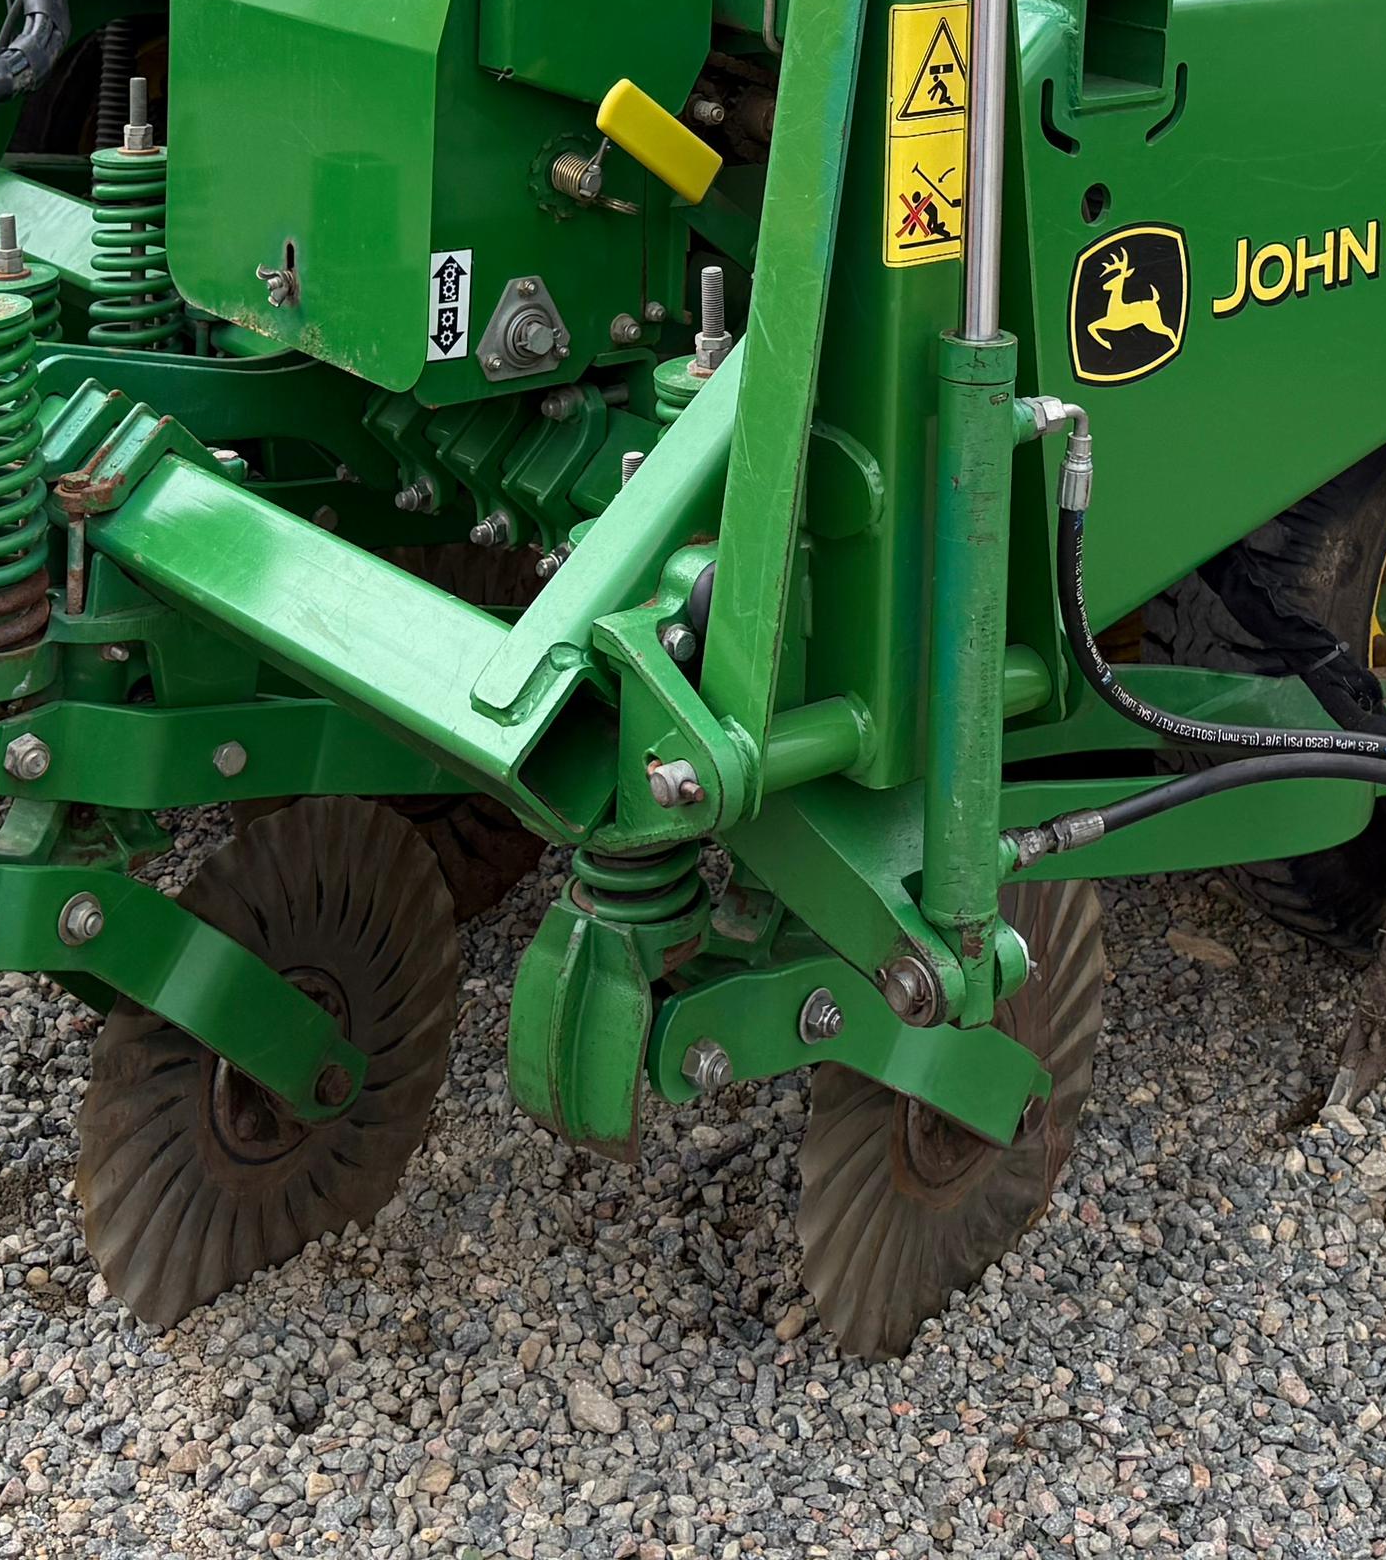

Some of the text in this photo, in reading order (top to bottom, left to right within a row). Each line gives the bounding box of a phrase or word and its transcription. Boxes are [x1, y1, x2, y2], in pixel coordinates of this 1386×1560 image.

[1212, 220, 1377, 316] JOHN
[1111, 684, 1138, 711] 100R17
[1136, 704, 1152, 721] SAE
[1156, 717, 1173, 731] R17
[1305, 736, 1333, 749] (3250
[1336, 738, 1357, 750] MPa
[1358, 741, 1379, 752] 22.5
